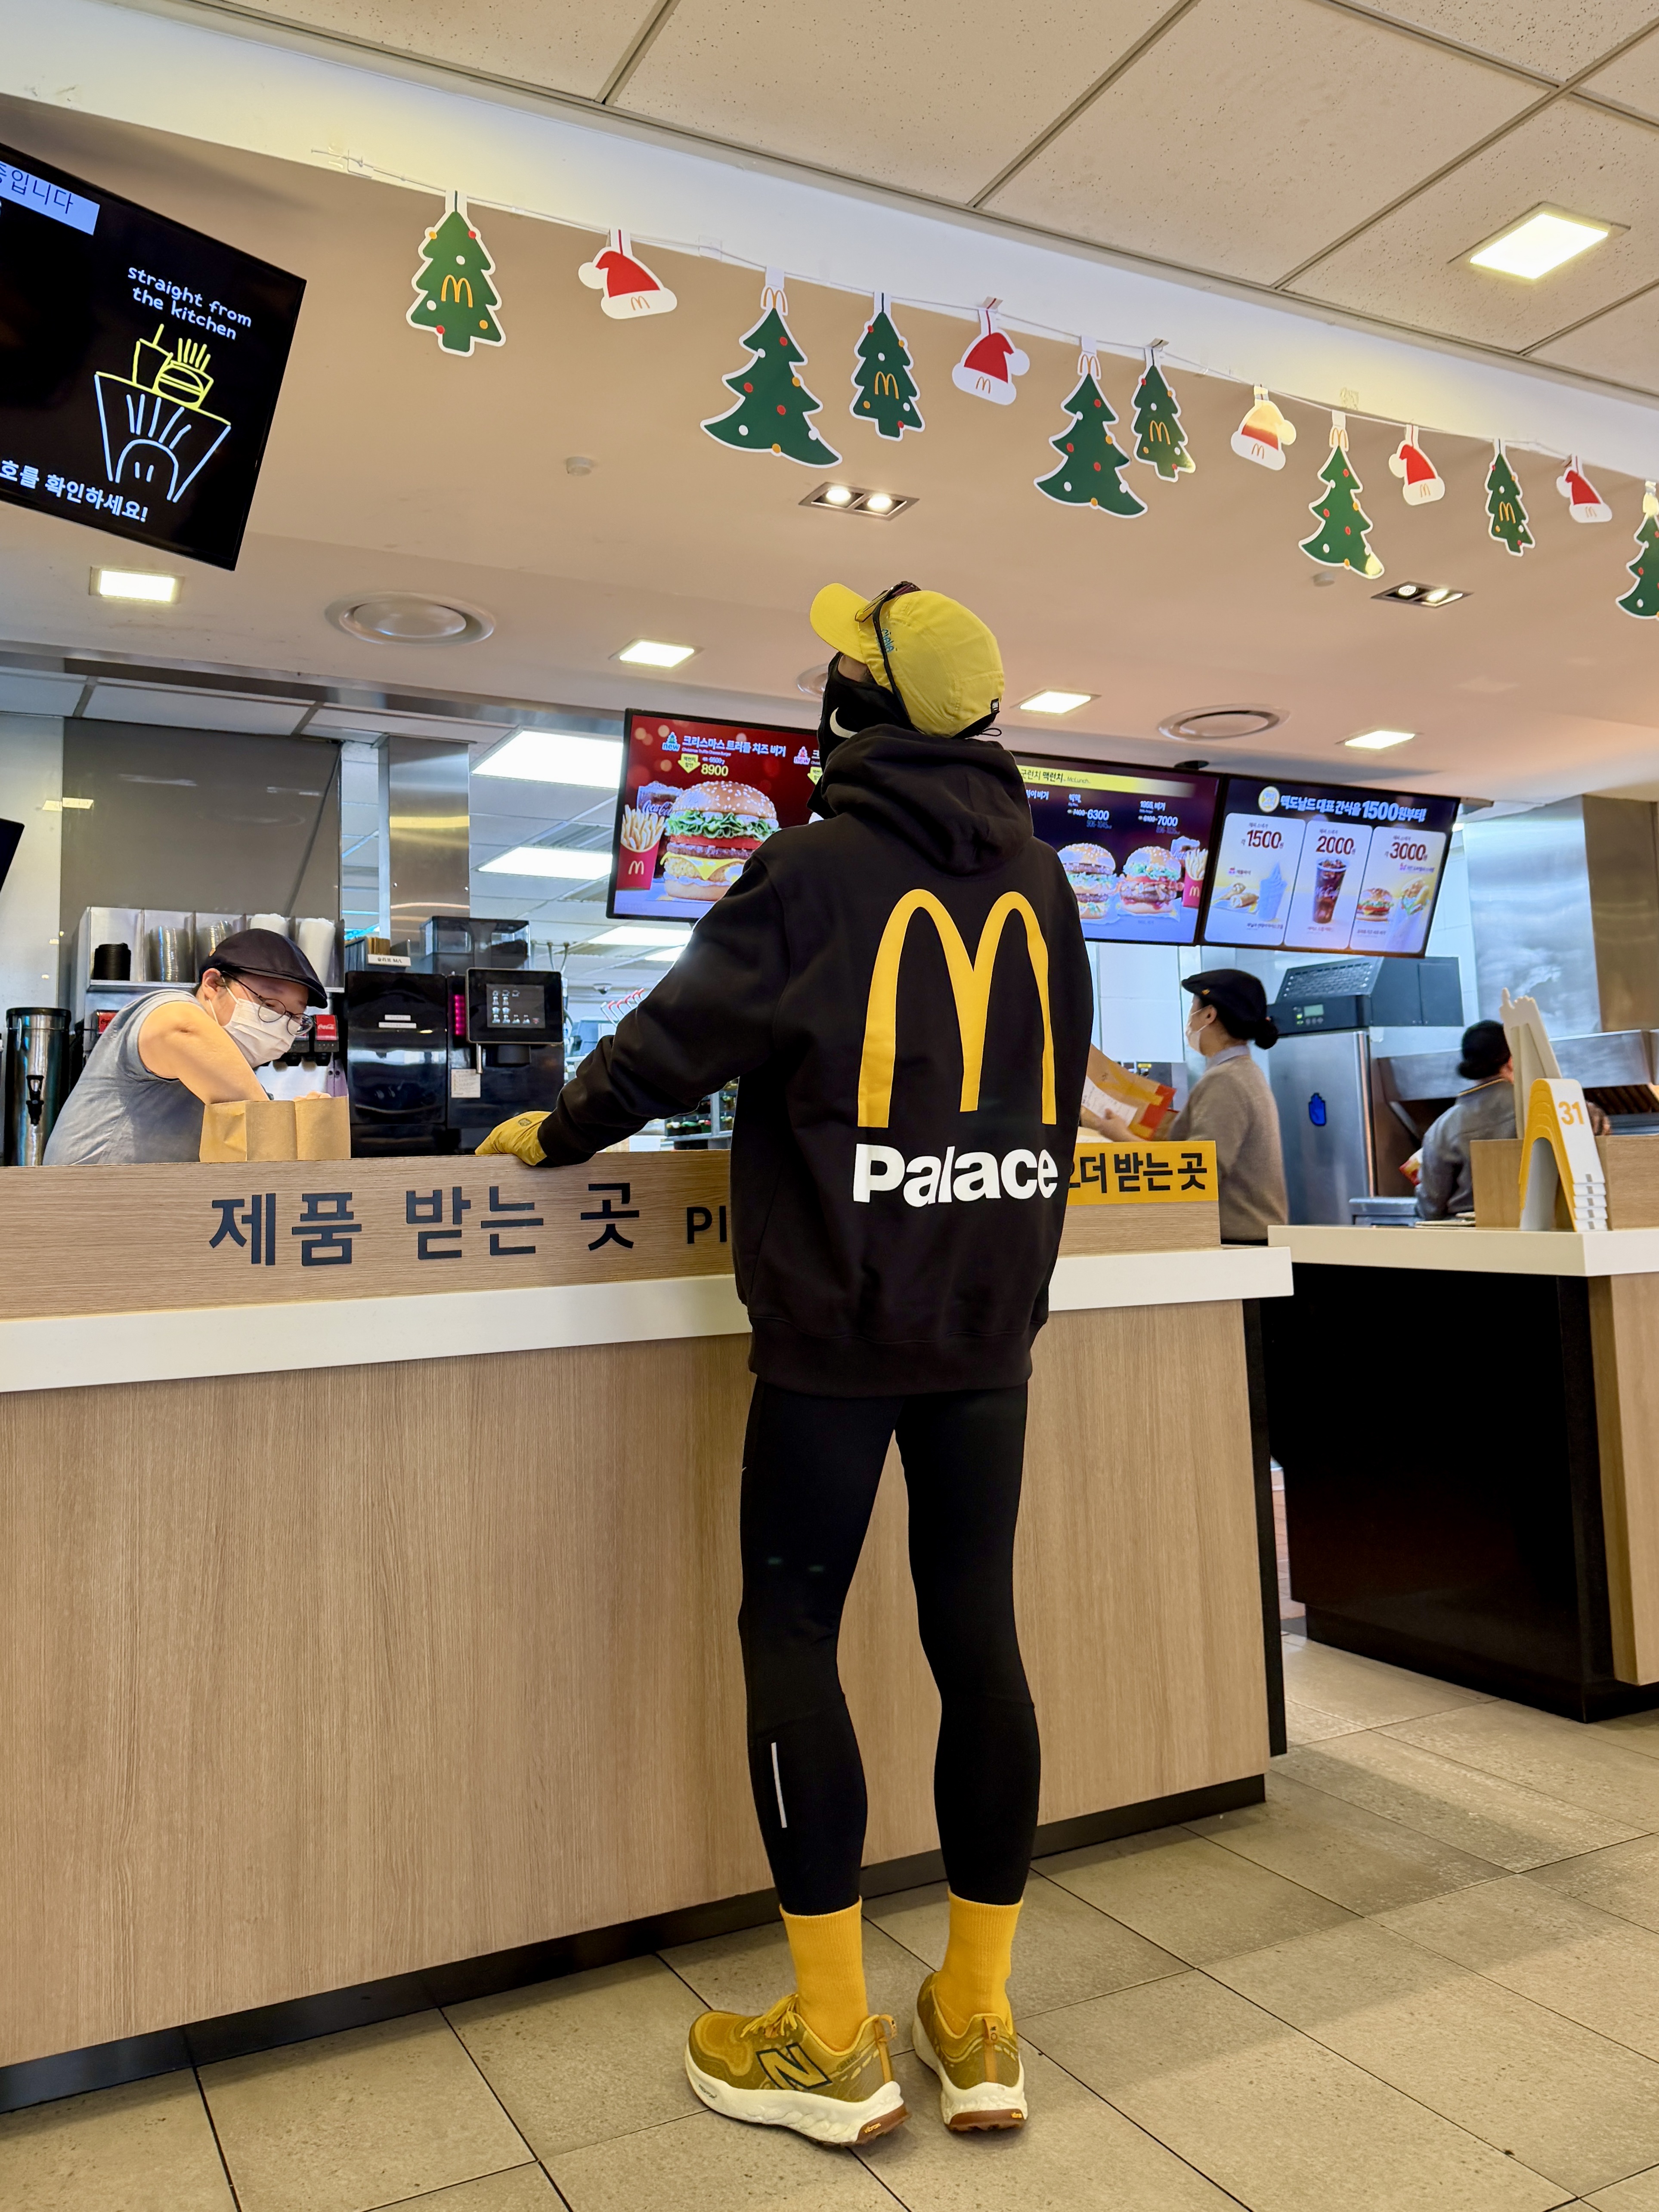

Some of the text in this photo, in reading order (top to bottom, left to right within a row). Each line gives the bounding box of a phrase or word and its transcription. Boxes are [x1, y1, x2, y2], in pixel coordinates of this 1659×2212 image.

[128, 267, 251, 328] straight from
[133, 287, 236, 340] the kitchen
[45, 474, 148, 523] 확인하세요!
[682, 735, 786, 758] 크리스마스 트러플 치즈 버거
[701, 764, 728, 777] 8900
[1043, 771, 1063, 783] 맥런치
[1087, 809, 1109, 821] 6300
[1280, 795, 1316, 811] 맥도날드
[1316, 798, 1335, 813] 대표
[1335, 800, 1362, 817] 간식을
[1158, 815, 1178, 827] 7000
[1558, 1101, 1584, 1125] 31
[853, 1143, 1058, 1207] Palace
[1114, 1152, 1173, 1192] 받는
[1178, 1153, 1207, 1191] 곳
[209, 1191, 362, 1266] 제품
[406, 1185, 544, 1260] 받는
[580, 1182, 640, 1251] 곳
